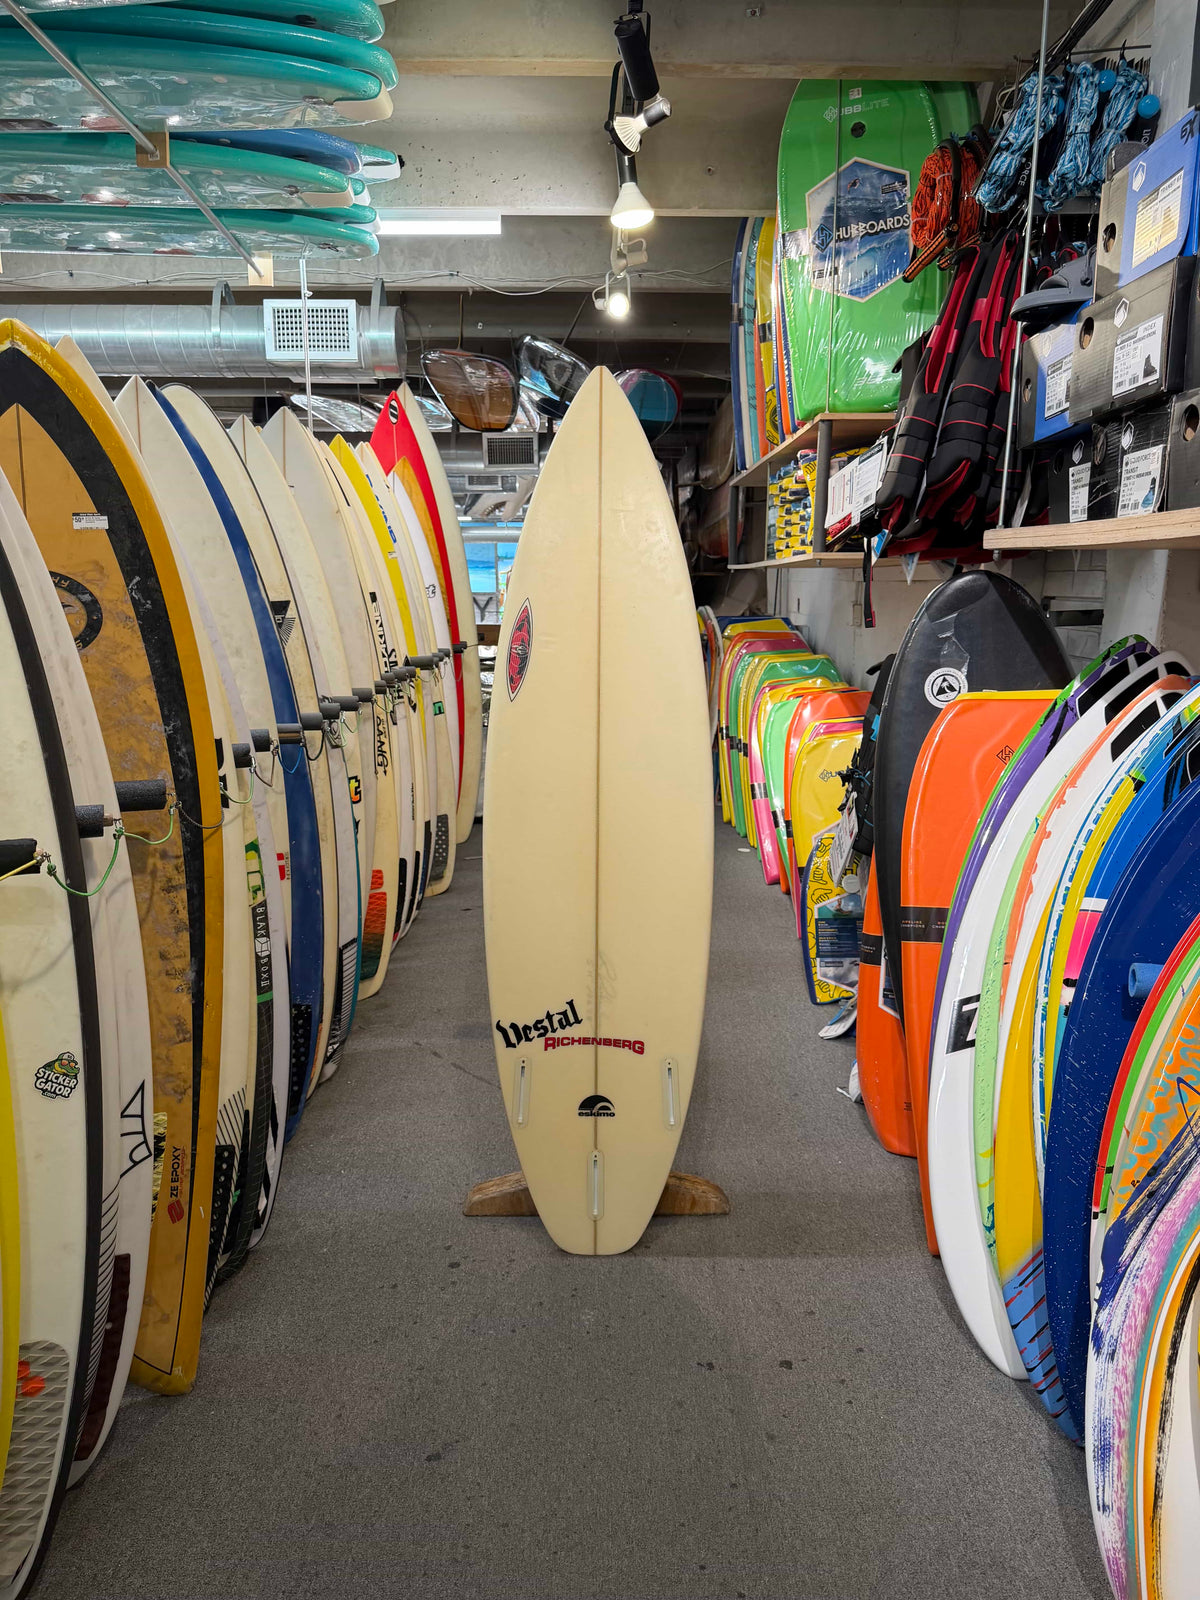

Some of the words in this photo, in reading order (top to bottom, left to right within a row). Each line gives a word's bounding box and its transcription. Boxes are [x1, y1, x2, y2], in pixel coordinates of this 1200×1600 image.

[835, 214, 911, 240] HUBBOARDS
[256, 906, 266, 937] BLAK
[496, 999, 583, 1048] Vestal
[544, 1037, 645, 1055] RICHENBERG
[35, 1078, 71, 1097] GATOR
[37, 1068, 77, 1088] STICKER
[577, 1109, 616, 1118] eskimo
[171, 1146, 181, 1183] EPOXY
[169, 1185, 179, 1199] ZE
